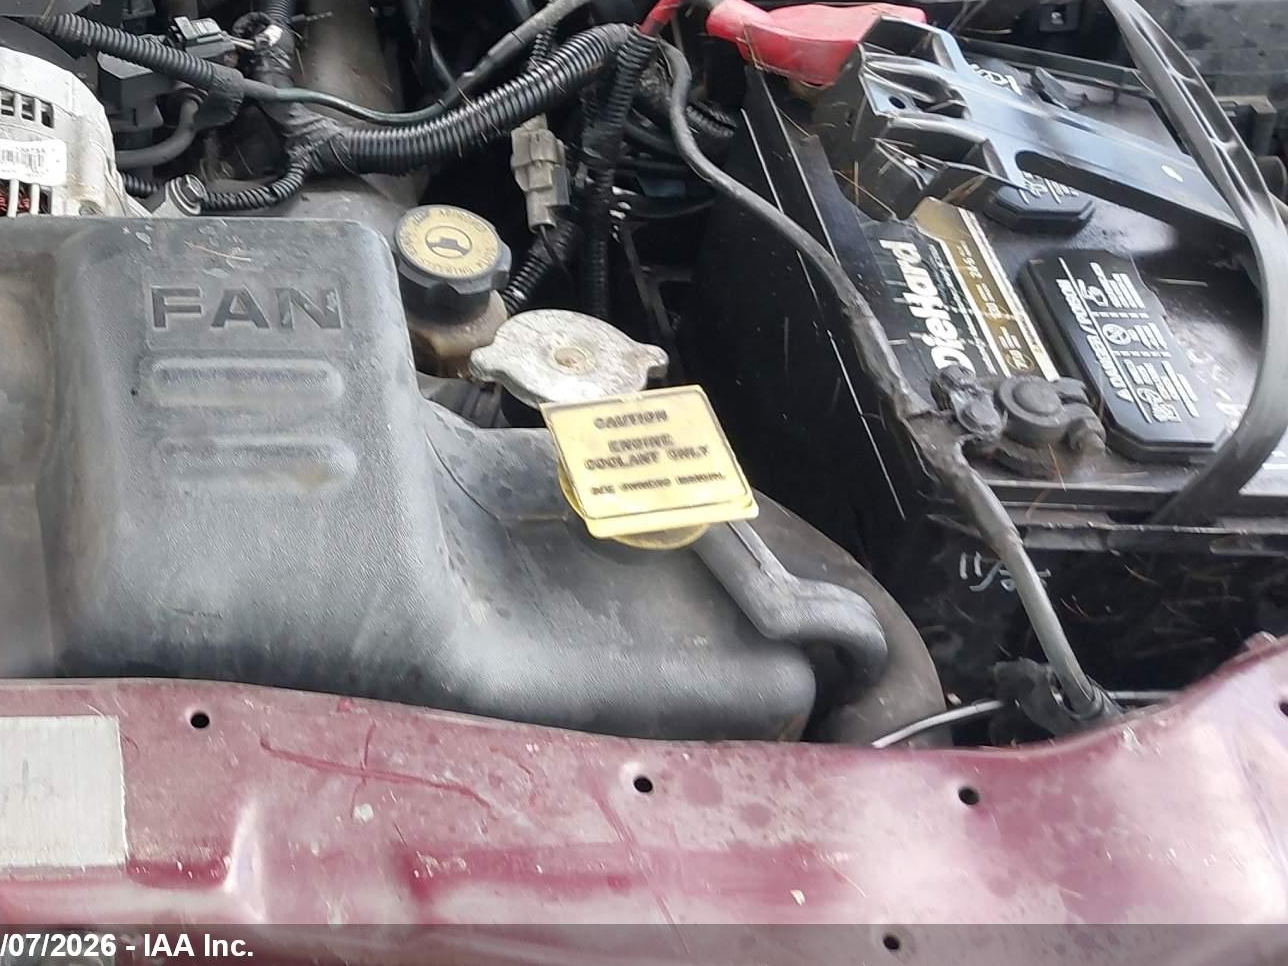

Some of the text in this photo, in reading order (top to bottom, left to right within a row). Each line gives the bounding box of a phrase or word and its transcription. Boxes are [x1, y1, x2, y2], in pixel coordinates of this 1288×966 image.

[151, 284, 344, 330] FAN
[879, 239, 976, 374] DieHard
[594, 410, 669, 429] CAUTION
[608, 434, 674, 453] ENGINE
[584, 445, 710, 471] COOLANT ONLY
